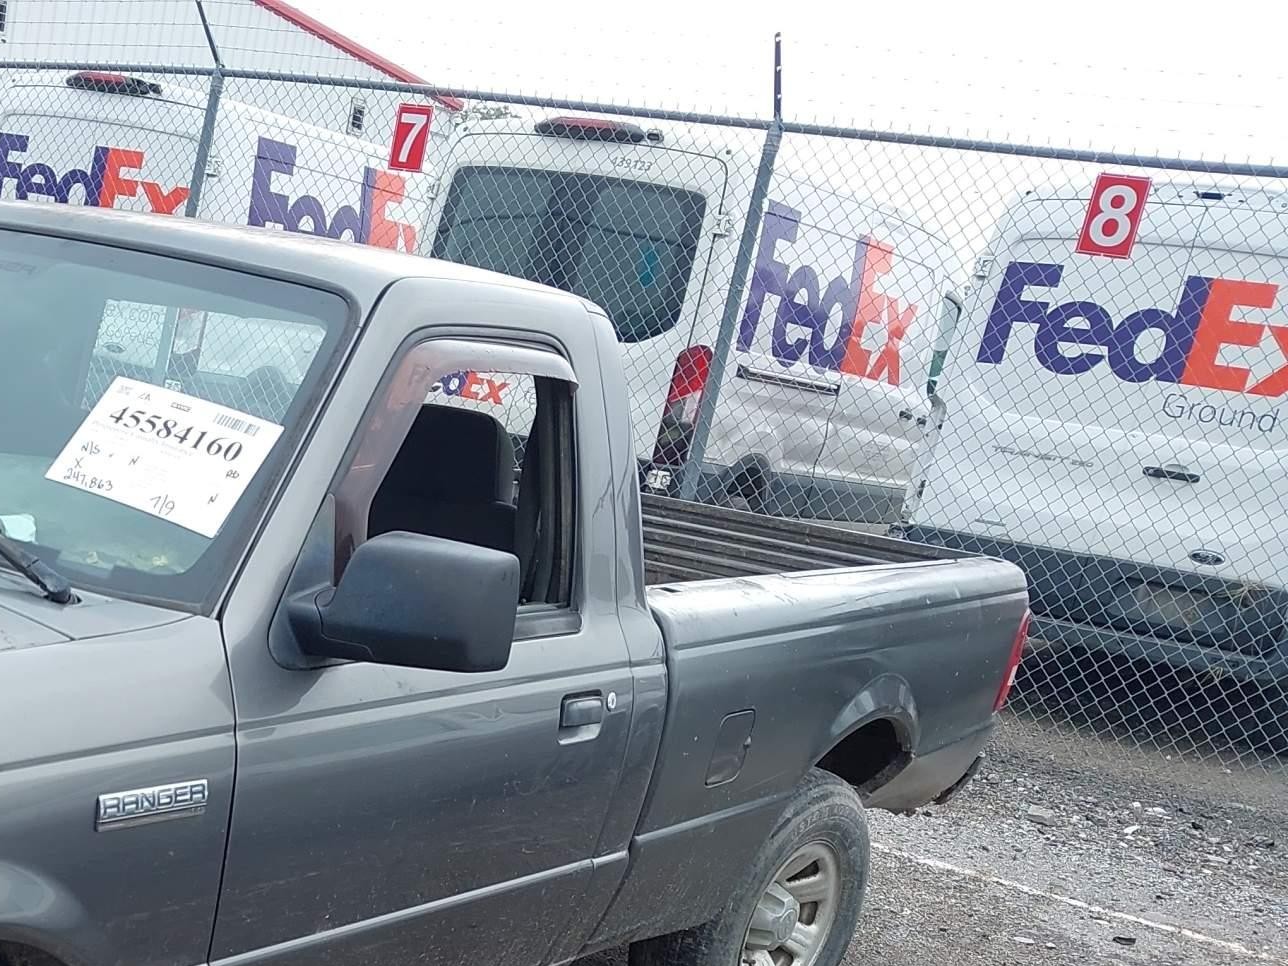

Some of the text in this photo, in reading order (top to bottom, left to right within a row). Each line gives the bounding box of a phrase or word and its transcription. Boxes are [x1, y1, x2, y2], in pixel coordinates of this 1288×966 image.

[397, 113, 428, 163] 7
[1088, 184, 1137, 247] 8
[735, 199, 919, 387] FedEx
[109, 405, 244, 462] 45584160
[1162, 393, 1280, 433] Ground
[100, 783, 206, 819] RANGER
